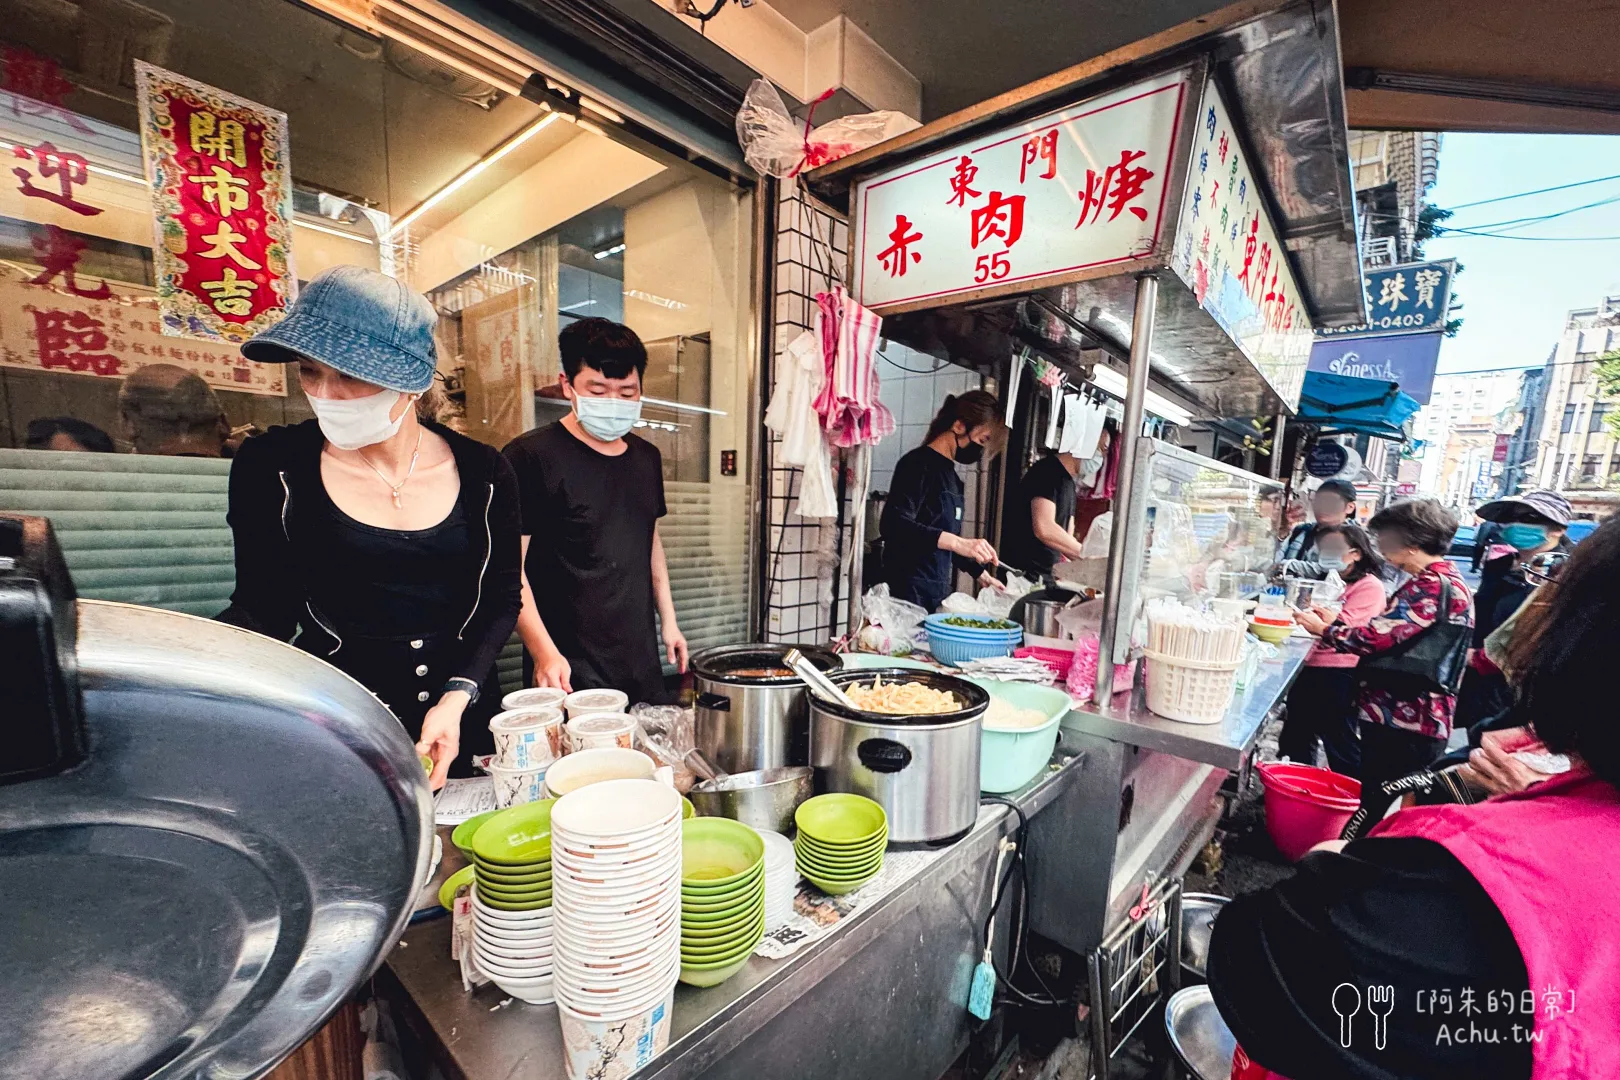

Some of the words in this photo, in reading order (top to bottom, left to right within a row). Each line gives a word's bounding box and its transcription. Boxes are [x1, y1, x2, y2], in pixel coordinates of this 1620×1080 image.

[188, 111, 262, 316] 開市大吉
[876, 150, 1154, 278] 赤肉焿
[946, 129, 1059, 207] 東門
[974, 250, 1011, 283] 55
